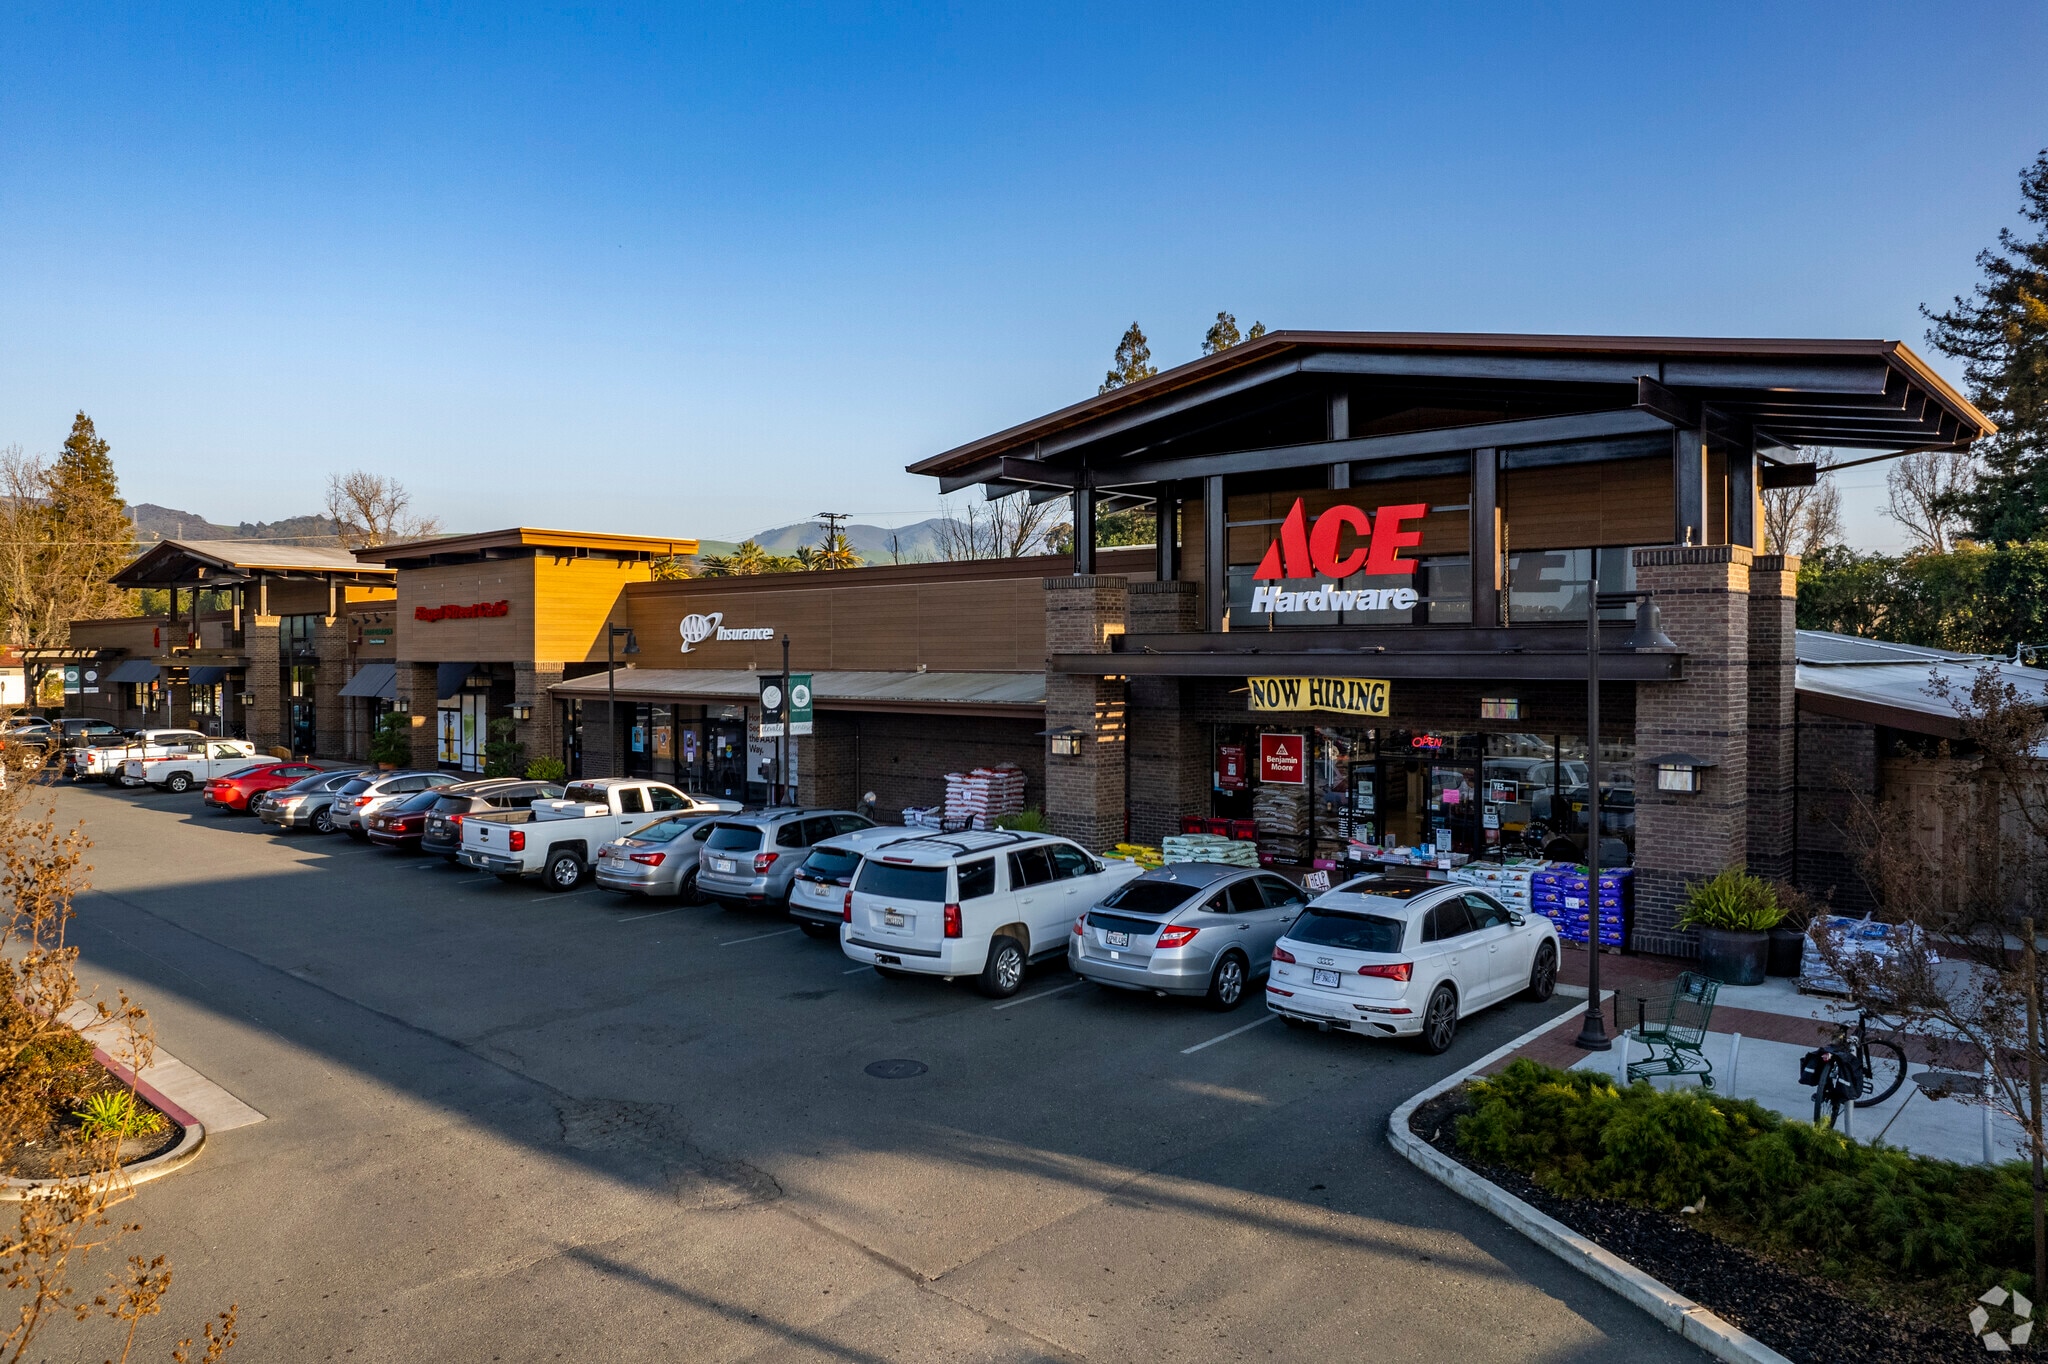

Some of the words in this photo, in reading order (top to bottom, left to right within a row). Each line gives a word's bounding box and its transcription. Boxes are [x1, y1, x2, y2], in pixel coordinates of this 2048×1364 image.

[1252, 496, 1428, 580] ACE
[1251, 584, 1418, 613] Hardware
[716, 626, 774, 640] Insurance
[1252, 679, 1301, 707] NOW
[1308, 678, 1385, 712] HIRING
[749, 734, 759, 743] the
[1412, 737, 1442, 747] OPEN
[749, 744, 764, 755] Way.
[1266, 756, 1298, 764] Benjamin
[1271, 763, 1293, 771] Moore
[1309, 872, 1326, 887] HELP
